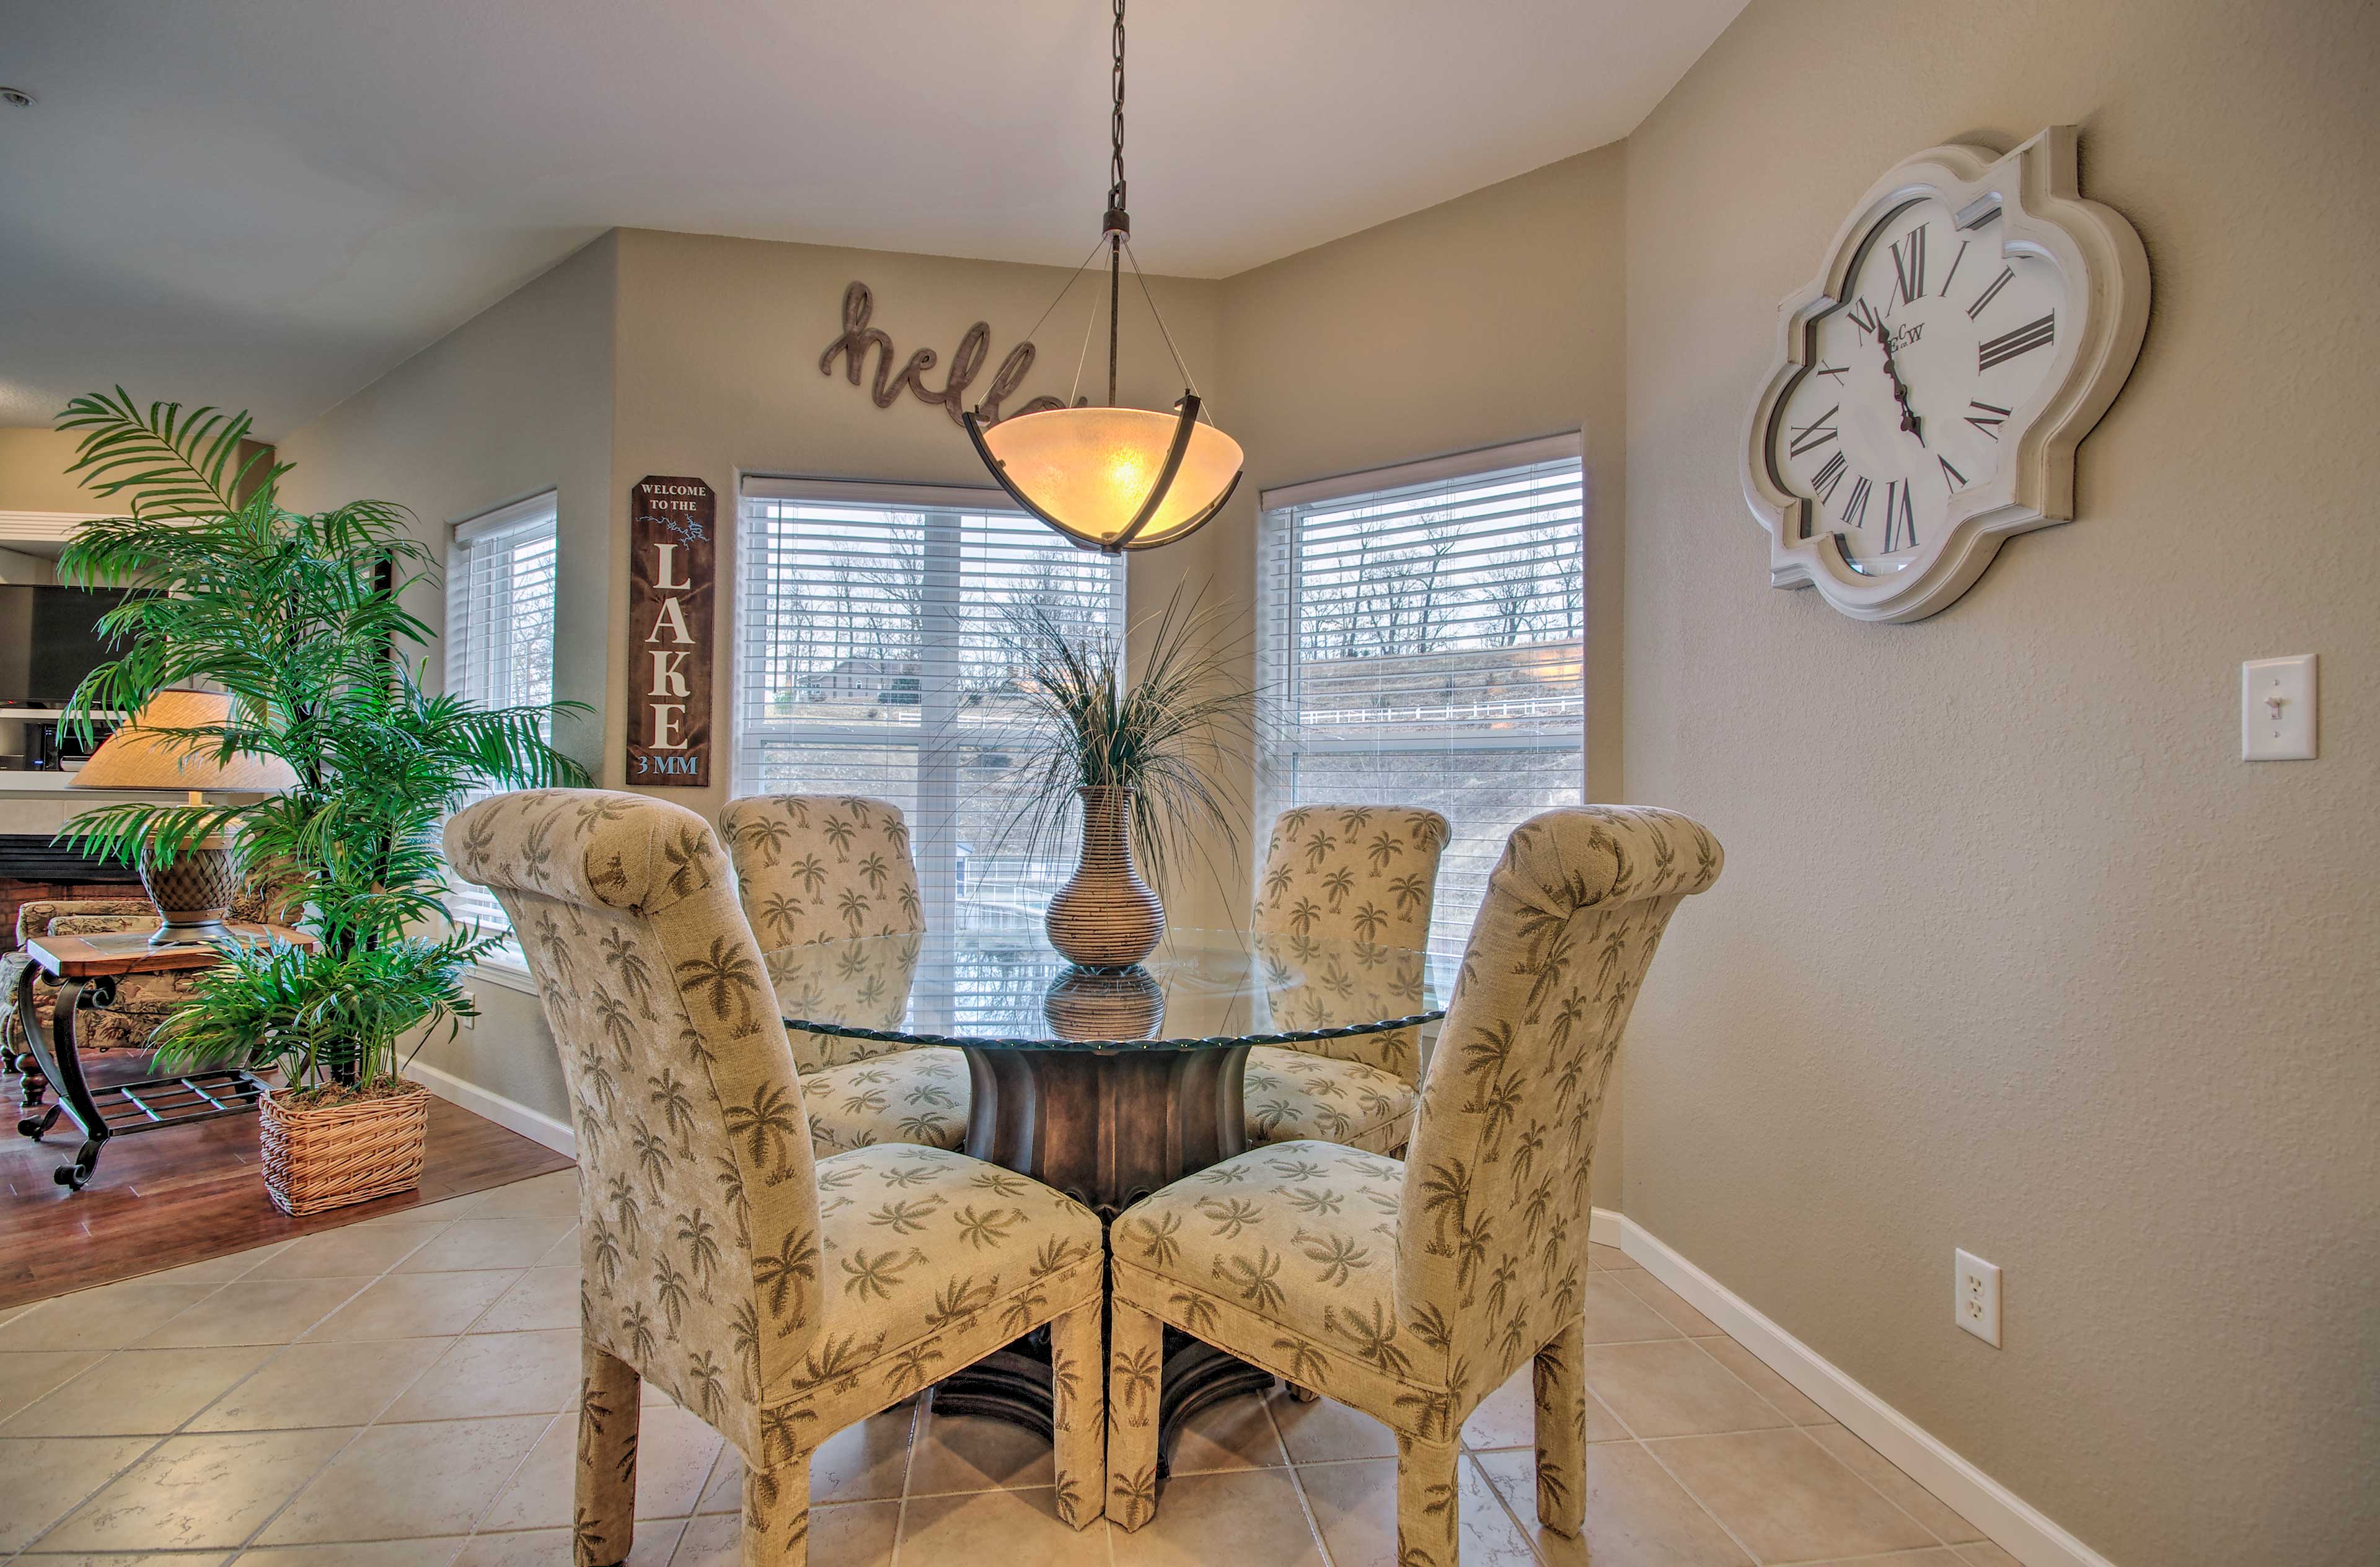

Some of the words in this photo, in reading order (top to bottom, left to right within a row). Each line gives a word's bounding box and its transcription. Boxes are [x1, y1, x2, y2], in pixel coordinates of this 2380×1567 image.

[1888, 222, 1930, 318] XII
[1978, 307, 2055, 377] III
[641, 484, 707, 496] WELCOME
[650, 499, 669, 510] TO
[670, 500, 697, 511] THE
[645, 543, 695, 750] LAKE
[637, 757, 648, 775] 3
[653, 757, 698, 775] MM
